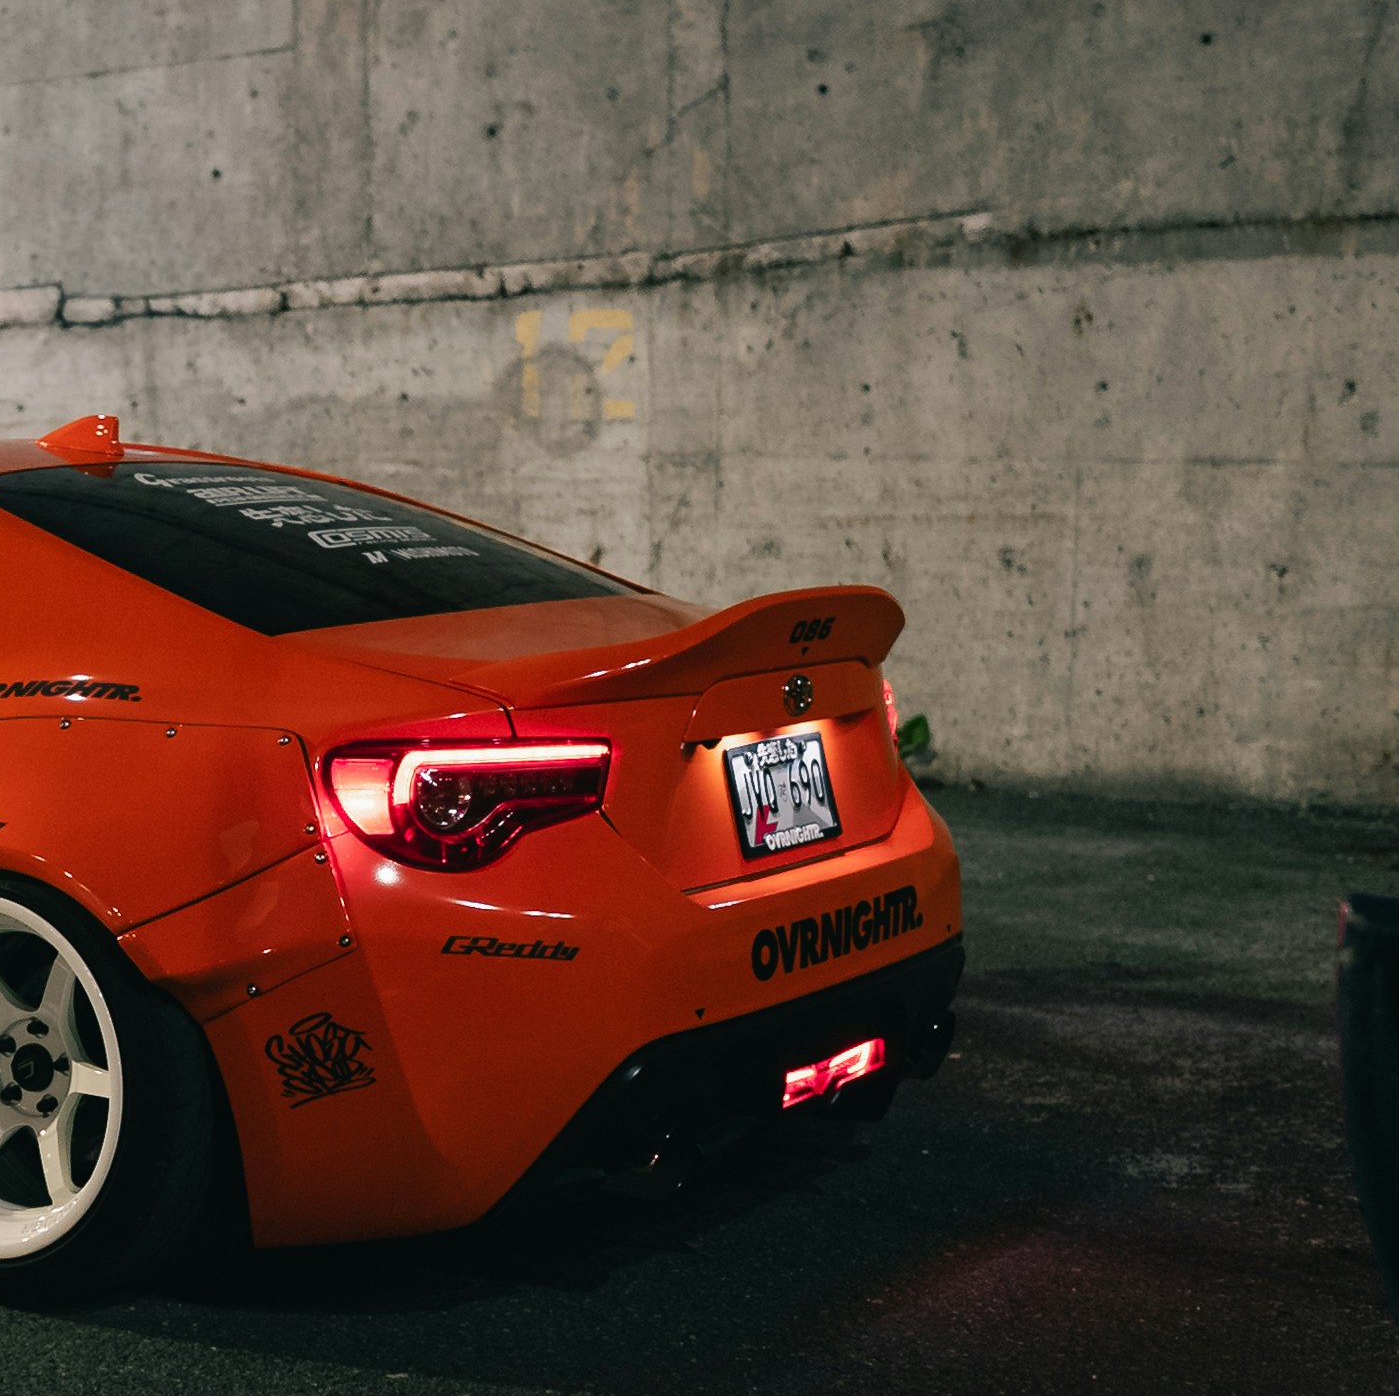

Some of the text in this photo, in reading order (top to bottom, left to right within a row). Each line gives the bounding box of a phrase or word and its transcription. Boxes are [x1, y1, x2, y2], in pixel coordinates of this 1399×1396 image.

[788, 616, 837, 644] 086
[788, 758, 826, 808] 690
[765, 822, 825, 852] OVRNIGHTR.
[440, 935, 581, 961] GReddy
[751, 885, 923, 982] OVRNIGHTR.
